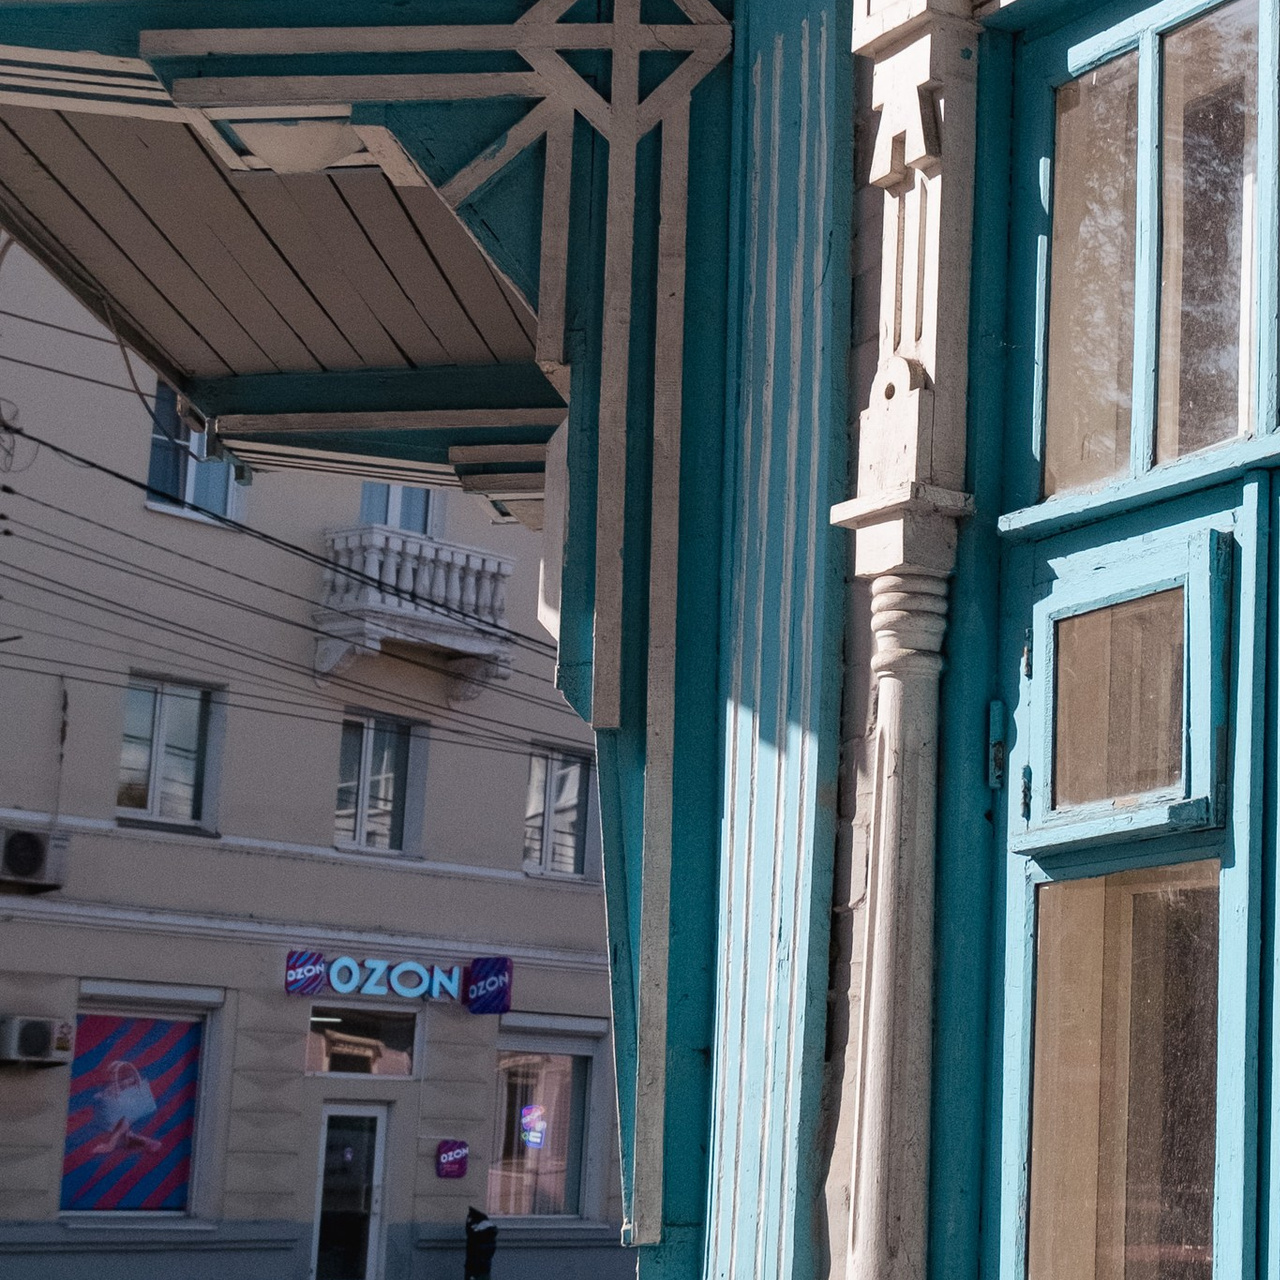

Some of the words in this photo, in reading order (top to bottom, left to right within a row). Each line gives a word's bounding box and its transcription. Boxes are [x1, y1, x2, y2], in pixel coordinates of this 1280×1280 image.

[287, 962, 325, 981] OZON
[329, 955, 461, 1000] OZON
[469, 971, 509, 999] OZON
[440, 1147, 469, 1163] OZON
